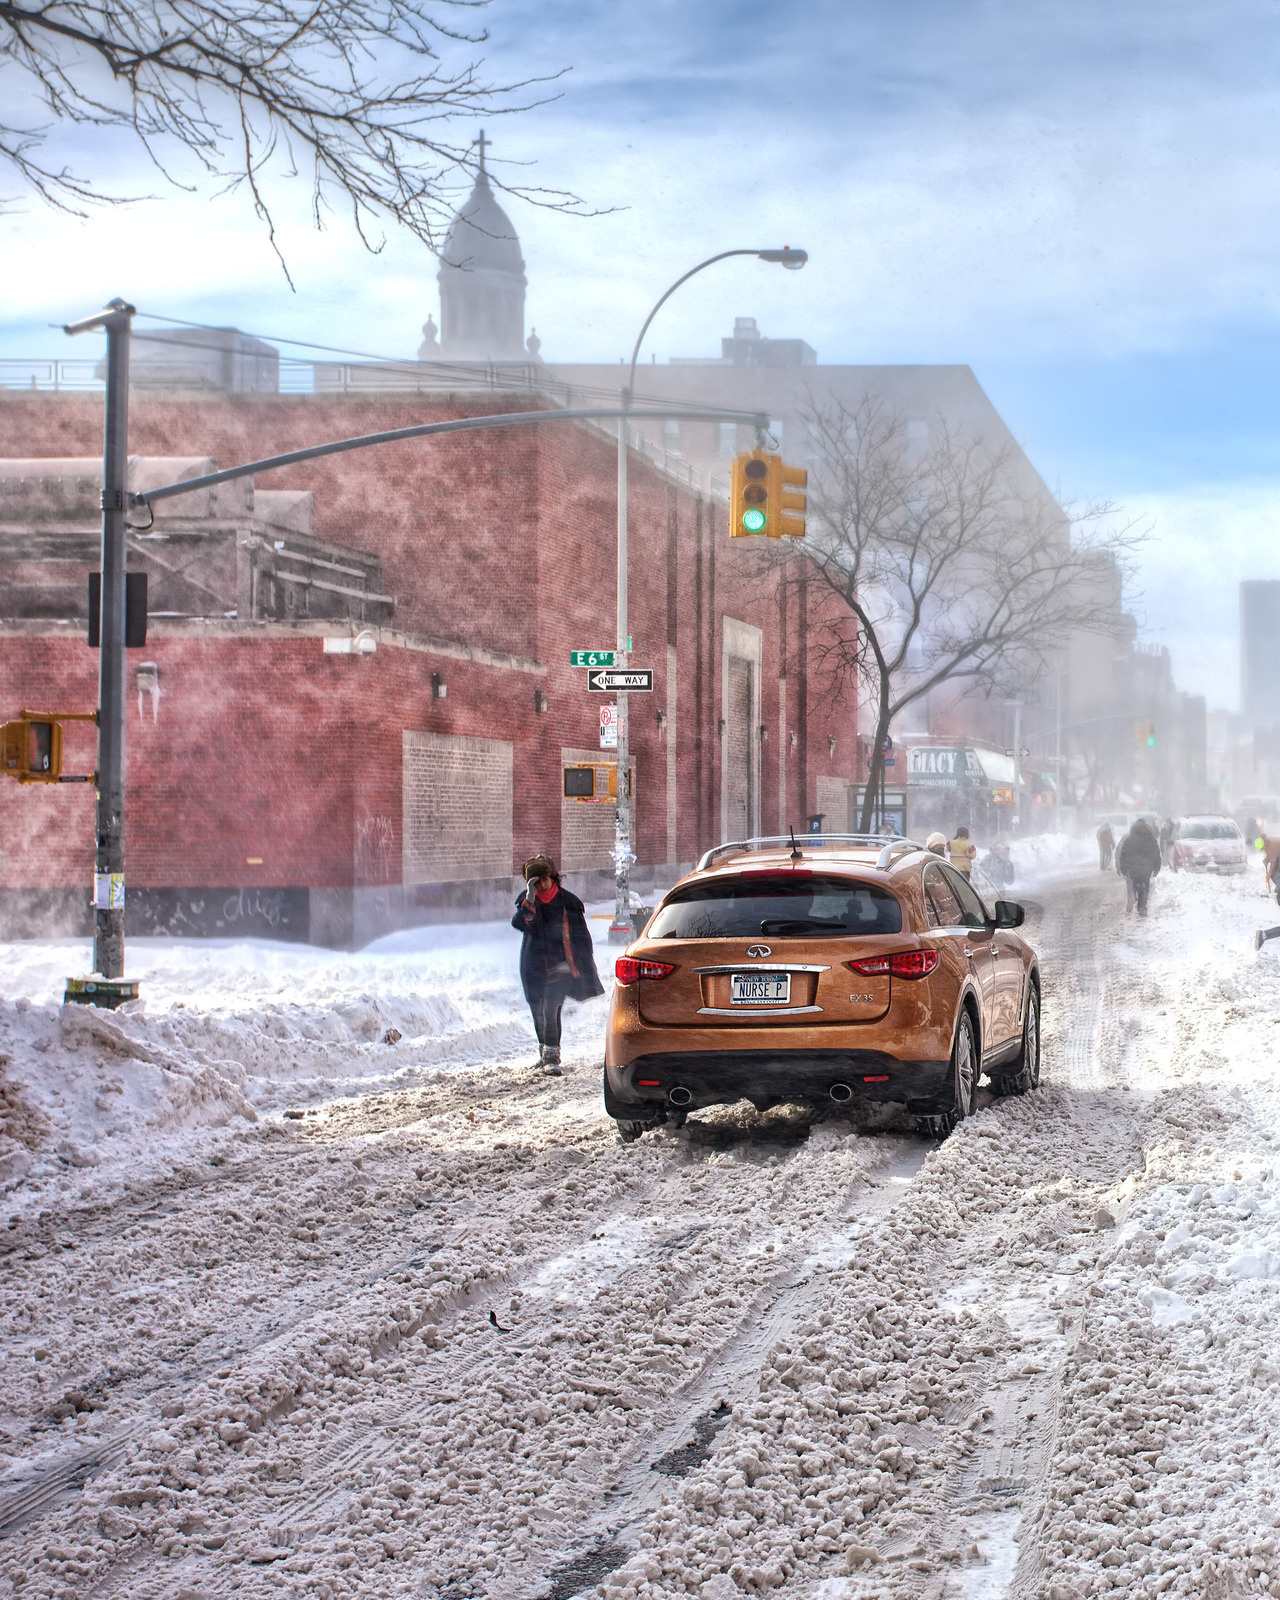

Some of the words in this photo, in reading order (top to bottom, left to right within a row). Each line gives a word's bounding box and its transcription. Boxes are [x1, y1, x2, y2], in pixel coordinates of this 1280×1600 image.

[577, 652, 585, 666] E
[588, 653, 597, 666] 6
[598, 676, 616, 685] ONE
[624, 676, 644, 685] WAY
[813, 821, 819, 830] P
[739, 982, 770, 997] NURSE
[776, 982, 782, 997] P
